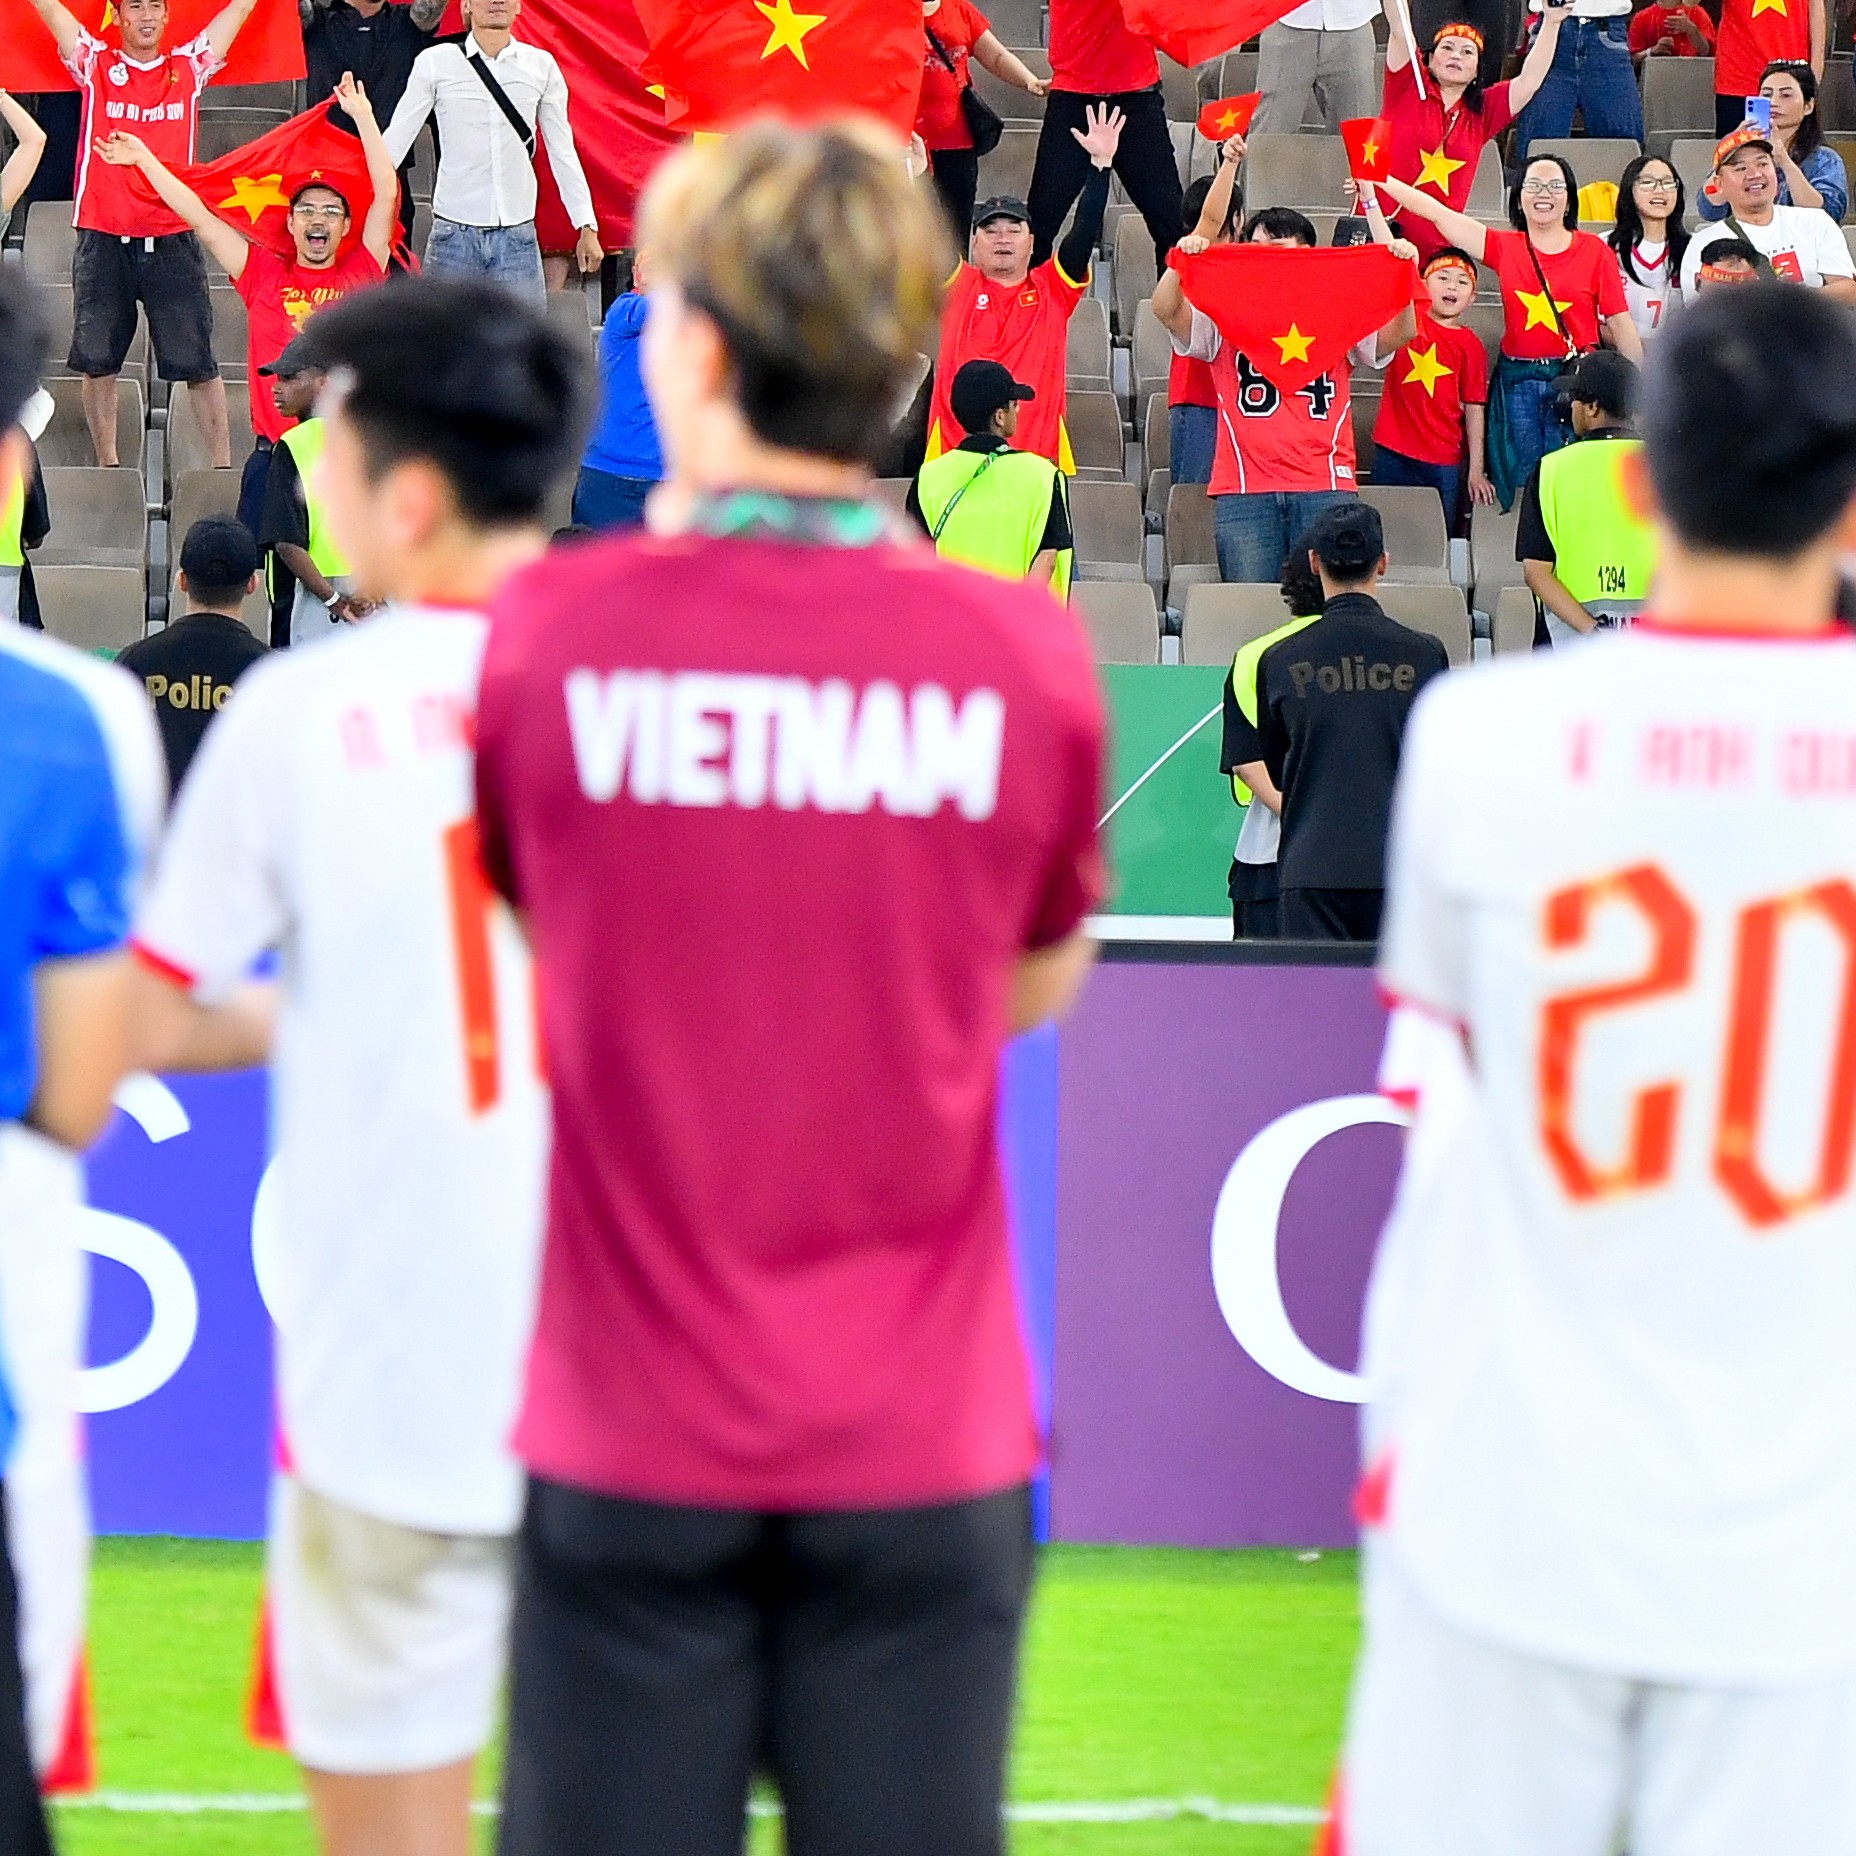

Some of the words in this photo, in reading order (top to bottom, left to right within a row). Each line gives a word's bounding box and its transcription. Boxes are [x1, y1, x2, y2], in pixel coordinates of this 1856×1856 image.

[1646, 300, 1663, 330] 7
[1236, 351, 1338, 420] 84
[1597, 565, 1626, 594] 1294
[1290, 656, 1416, 698] Police
[562, 665, 1005, 823] VIETNAM
